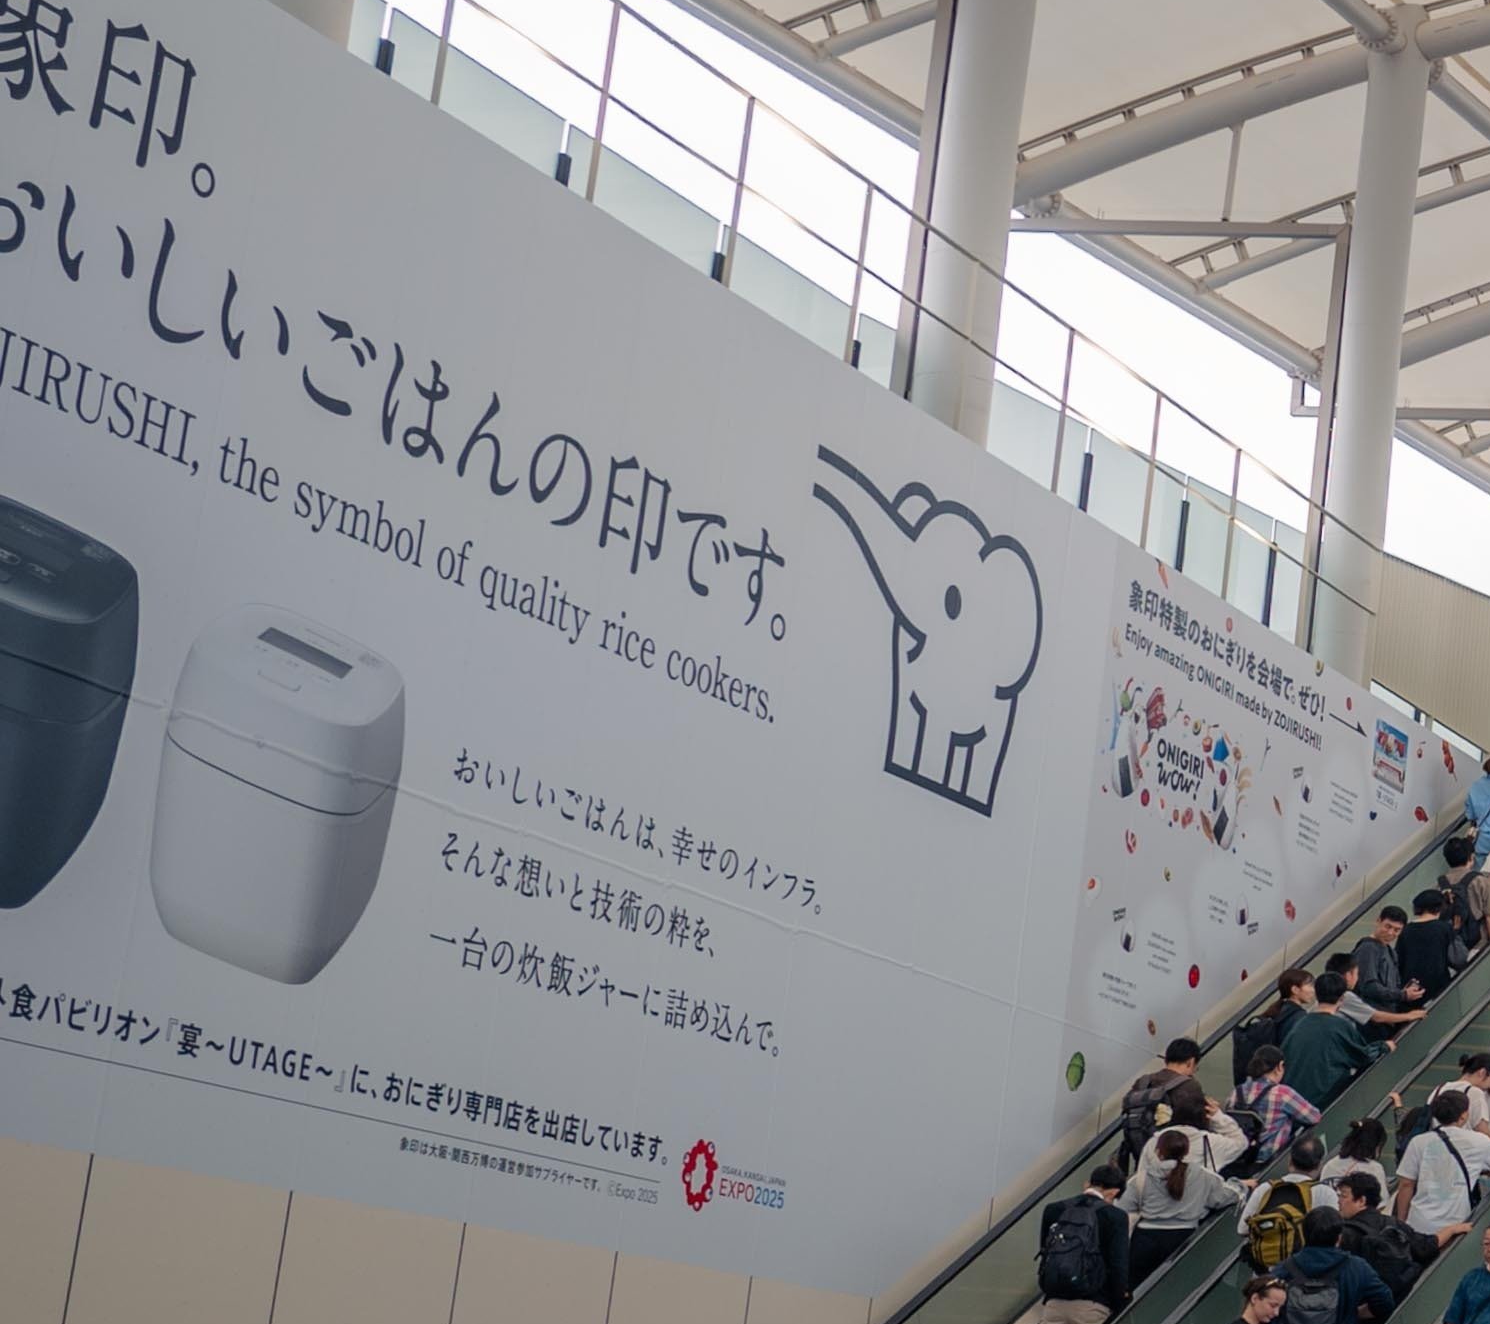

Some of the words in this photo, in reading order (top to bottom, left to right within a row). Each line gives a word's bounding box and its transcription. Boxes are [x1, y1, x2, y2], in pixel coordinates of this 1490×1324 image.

[220, 438, 279, 503] the
[294, 479, 424, 568] symbol
[437, 541, 473, 587] of
[480, 561, 591, 645] quality
[600, 616, 655, 669] rice
[667, 641, 776, 725] cookers.
[1125, 623, 1153, 656] Enjoy
[1154, 644, 1195, 682] amazing
[1197, 665, 1235, 702] ONIGIRI
[1236, 690, 1261, 717] made
[1262, 702, 1274, 726] by
[1157, 738, 1204, 779] ONIGIRI
[454, 748, 822, 915] おいしいごはんは、幸せのインフラ。
[441, 833, 714, 958] そんな想いと技術の粋を、
[430, 927, 779, 1057] 一台の炊飯ジャーに詰め込んで。
[637, 1186, 659, 1205] 2025
[719, 1177, 785, 1209] EXPO2025
